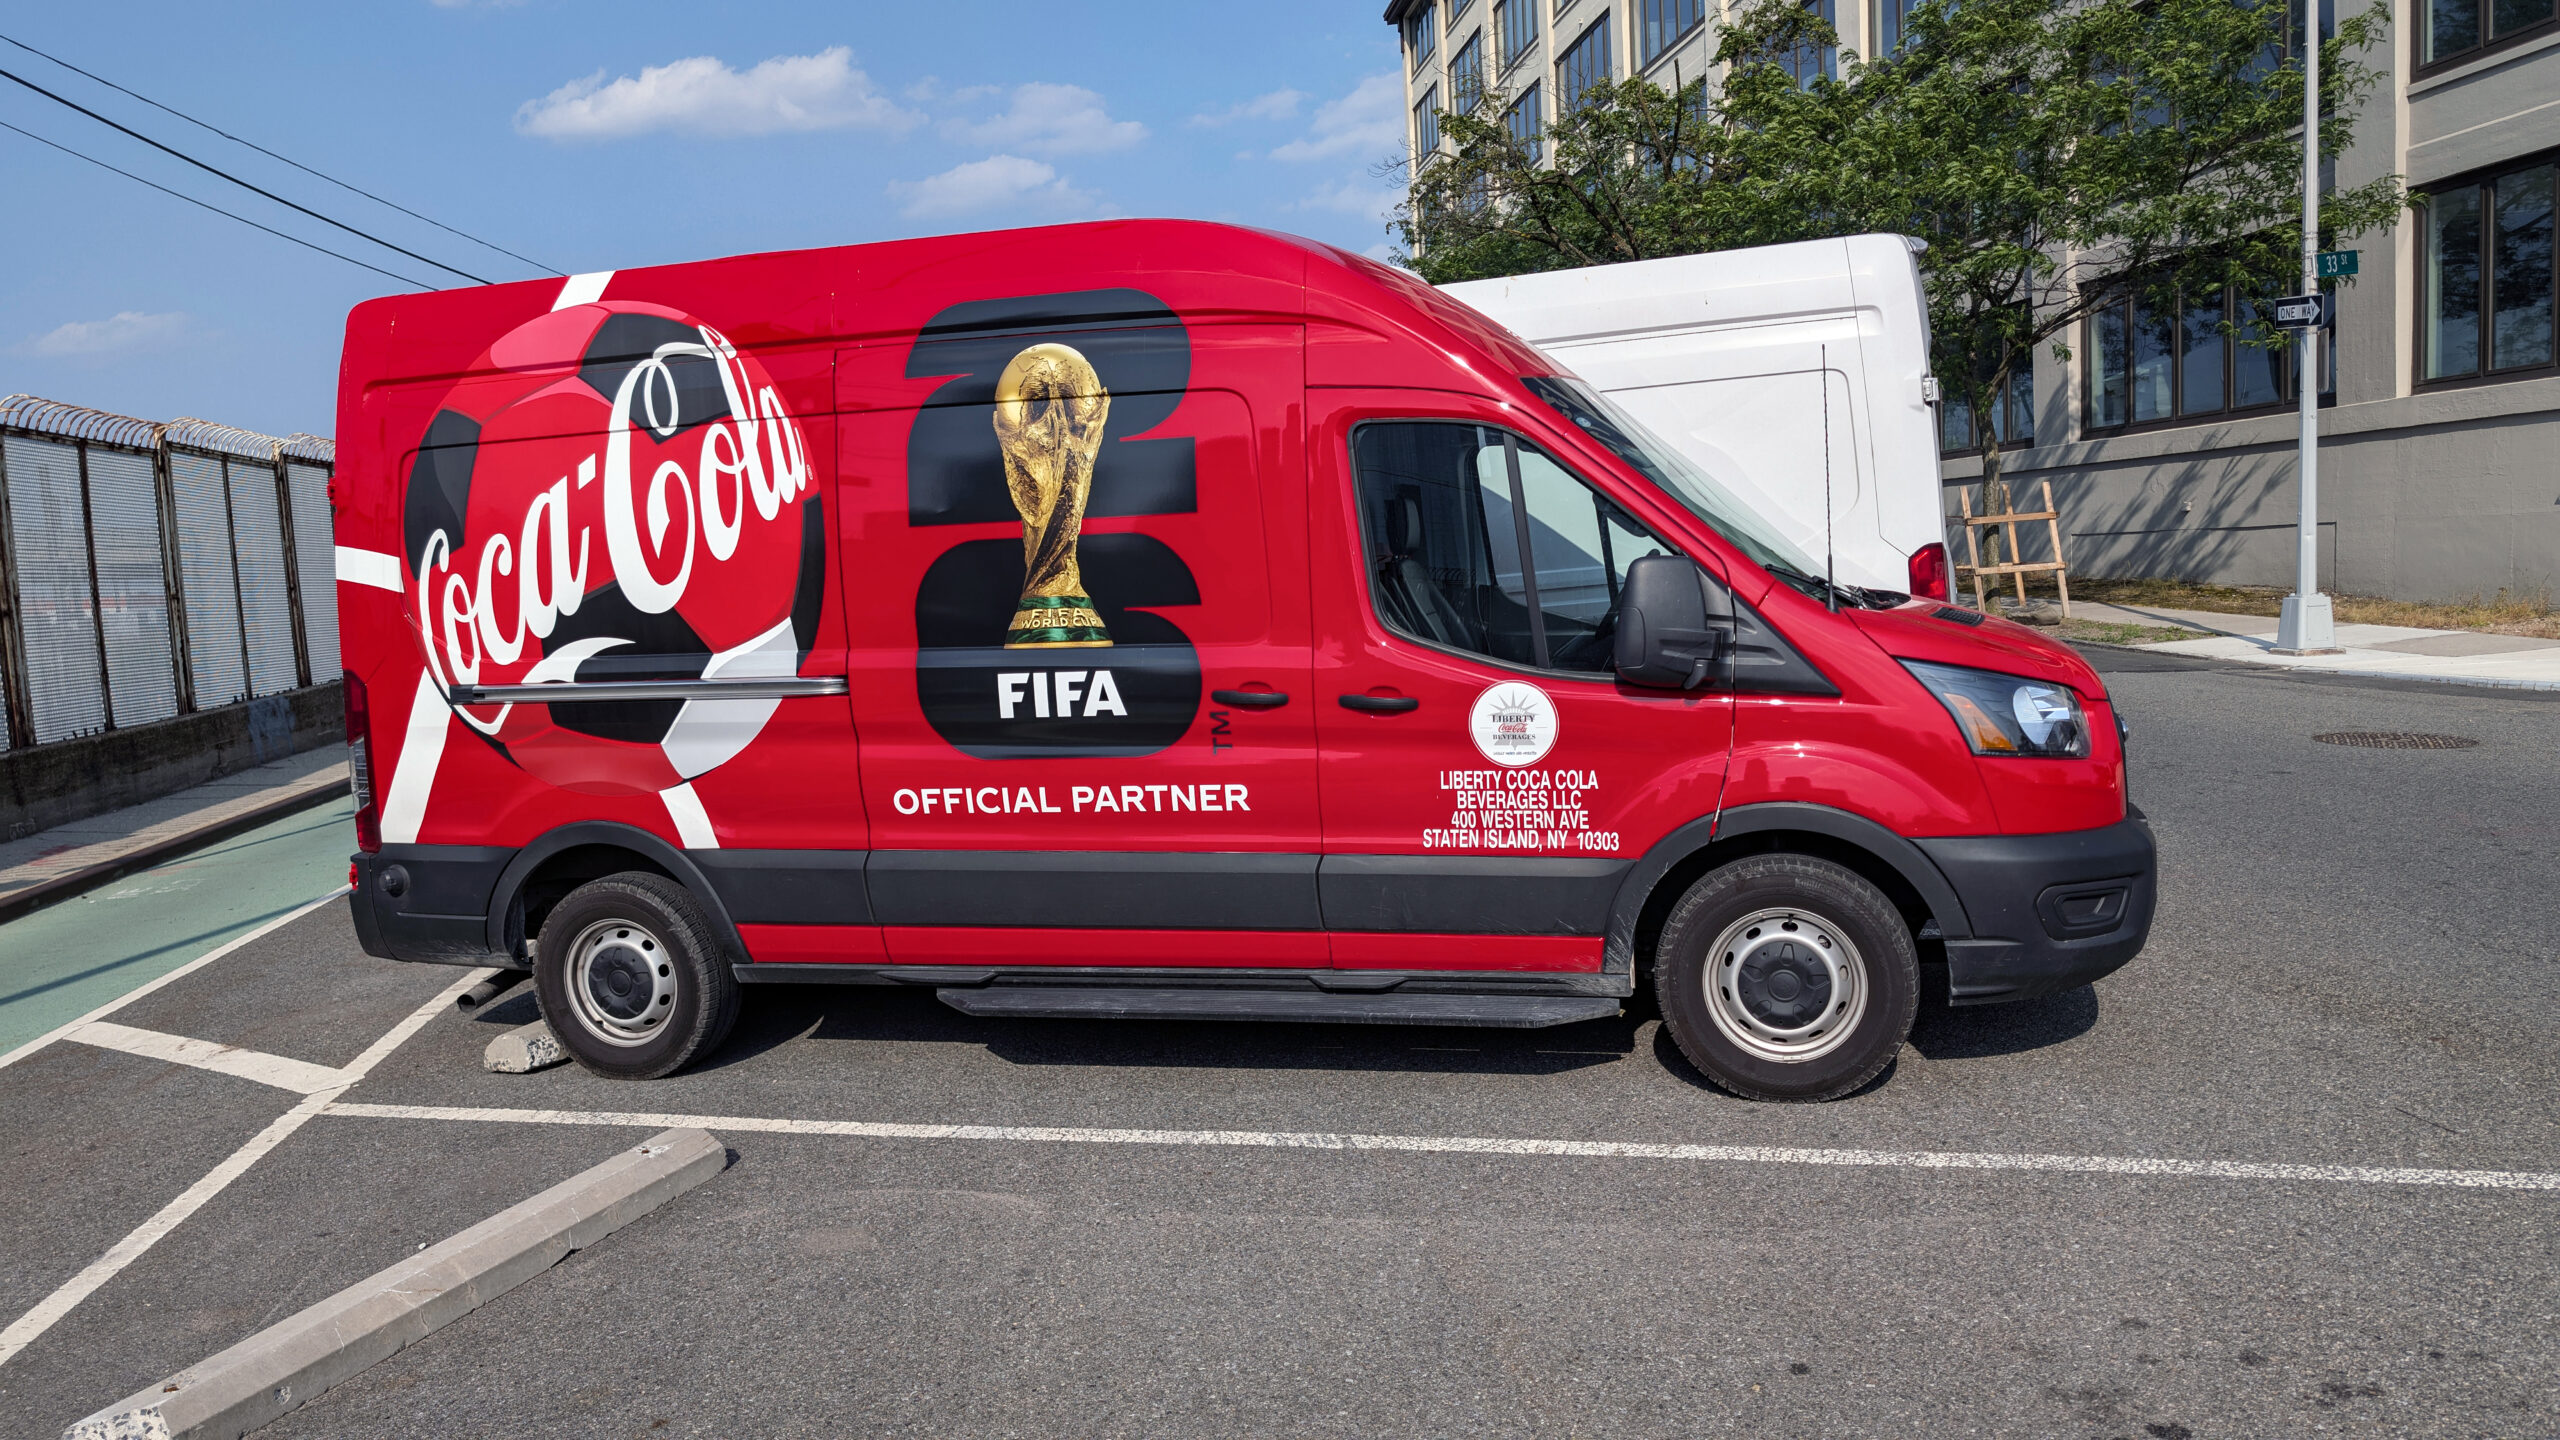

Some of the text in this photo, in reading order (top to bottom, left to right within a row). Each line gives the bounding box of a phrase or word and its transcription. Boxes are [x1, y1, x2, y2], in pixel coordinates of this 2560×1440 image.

[2326, 254, 2348, 273] 33 St
[2280, 305, 2316, 319] ONE WAY
[418, 324, 807, 736] Coca-Cola
[1021, 617, 1098, 628] WORLD CUP
[1031, 608, 1085, 619] FIFA
[997, 670, 1128, 719] FIFA
[1492, 714, 1535, 723] LIBERTY
[1213, 710, 1233, 756] TM
[1440, 770, 1599, 790] LIBERTY COCA COLA
[893, 784, 1251, 815] OFFICIAL PARTNER
[1457, 790, 1582, 810] BEVERAGES LLC
[1451, 811, 1589, 829] 400 WESTERN AVE
[1423, 829, 1619, 852] STATEN ISLAND, NY 10303
